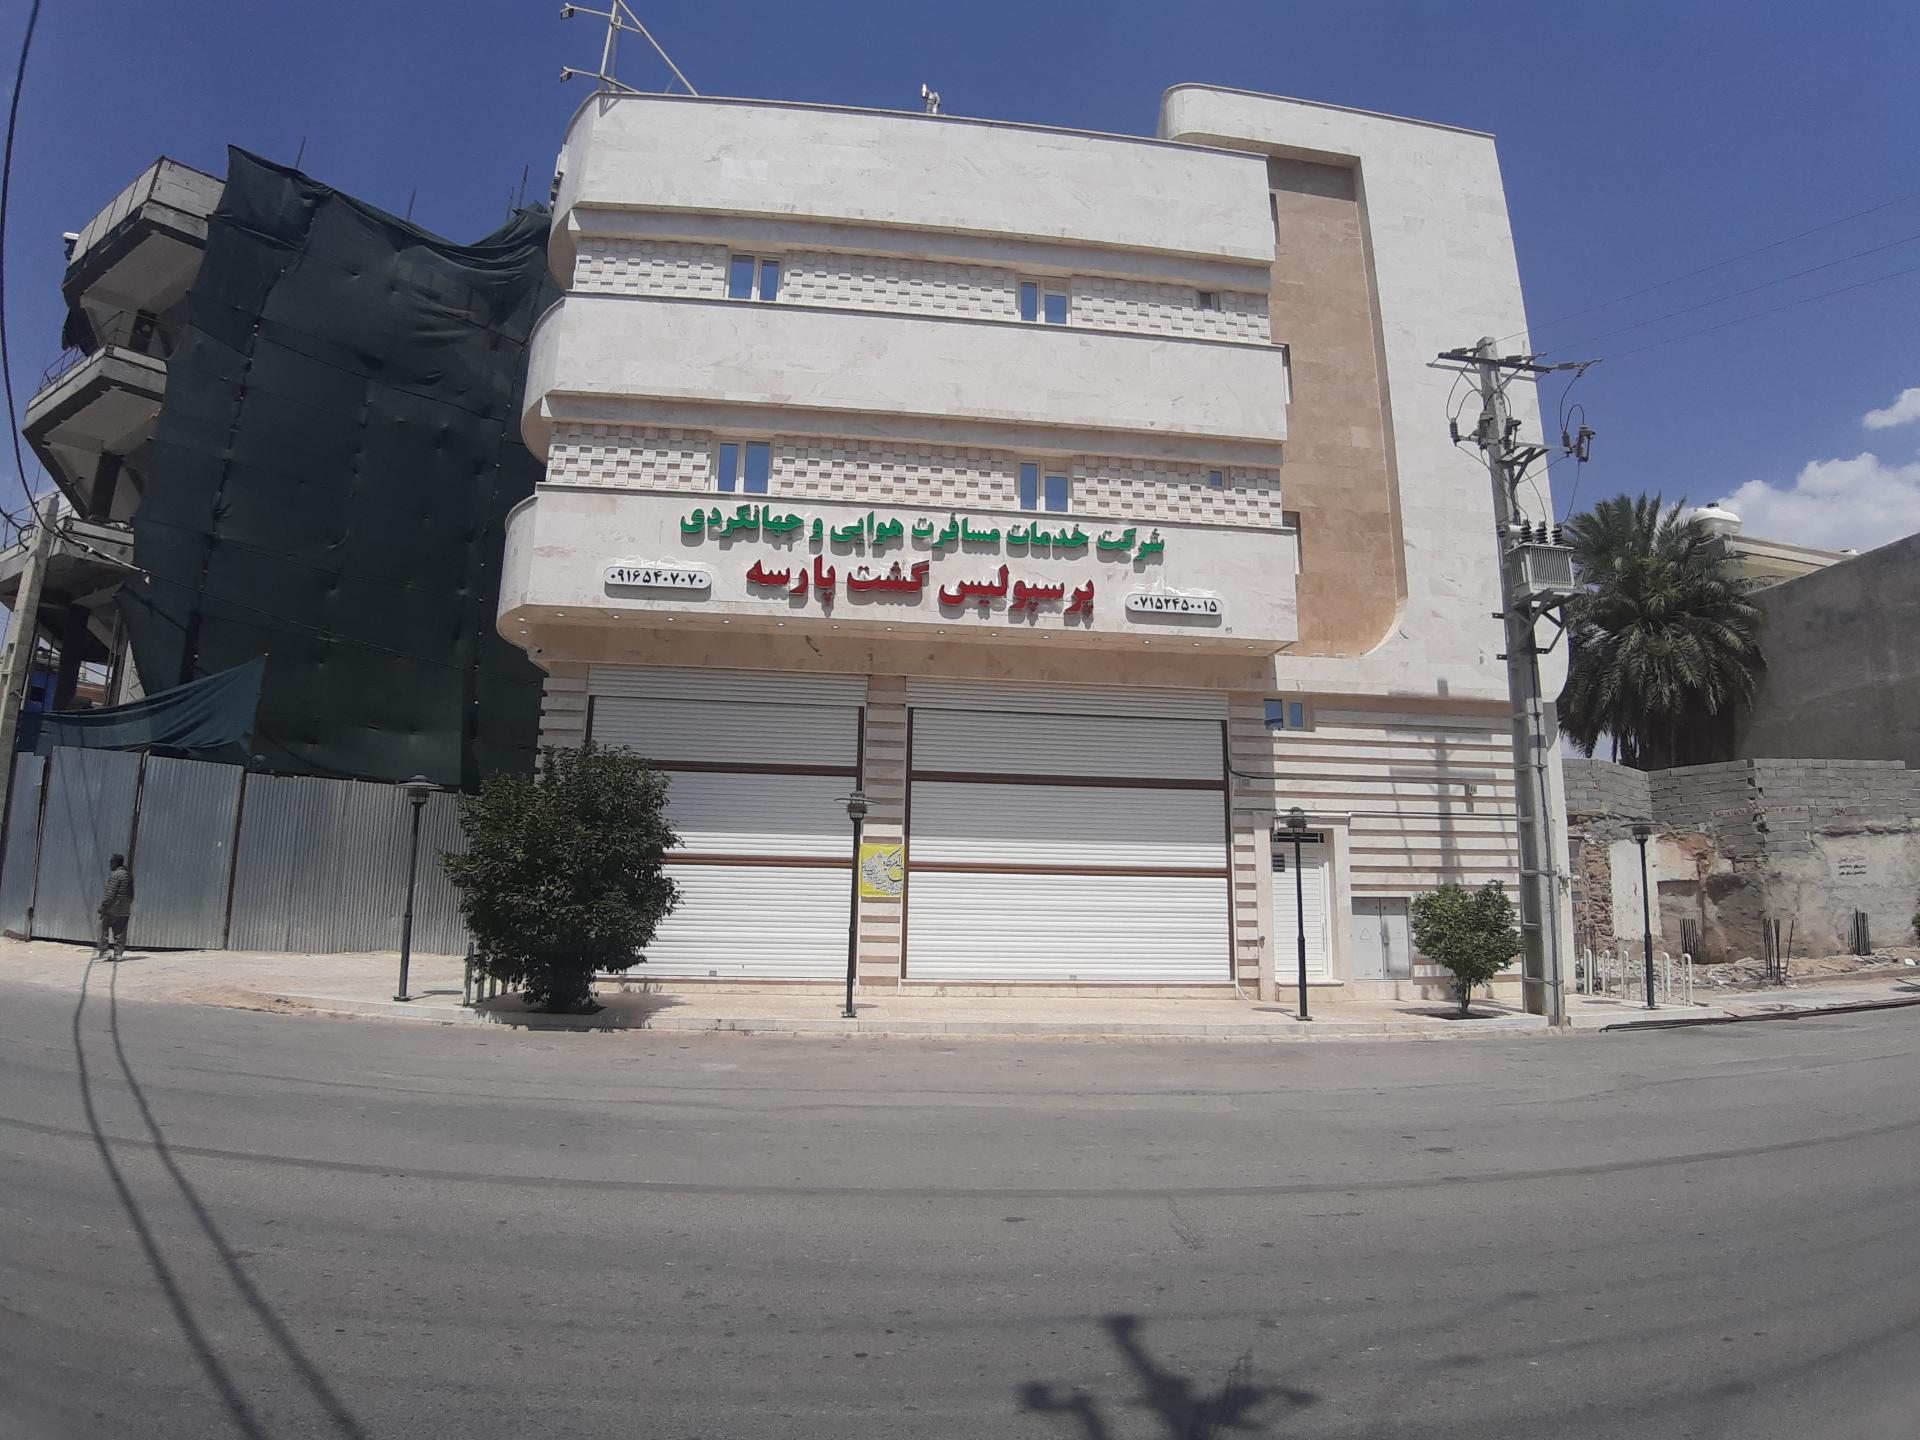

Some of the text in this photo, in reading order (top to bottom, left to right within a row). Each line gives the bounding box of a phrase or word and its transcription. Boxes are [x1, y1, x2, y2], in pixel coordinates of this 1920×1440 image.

[681, 504, 1165, 560] شرکت خدمات مسافرت هوایی و جهانگردی
[610, 569, 703, 586] ۰۹۱۶۵۴۰۷۰۷۰
[746, 554, 1095, 617] پرسپولیس گشت پارسه
[1134, 596, 1217, 612] ۰۷۱۵۲۴۵۰۰۱۵
